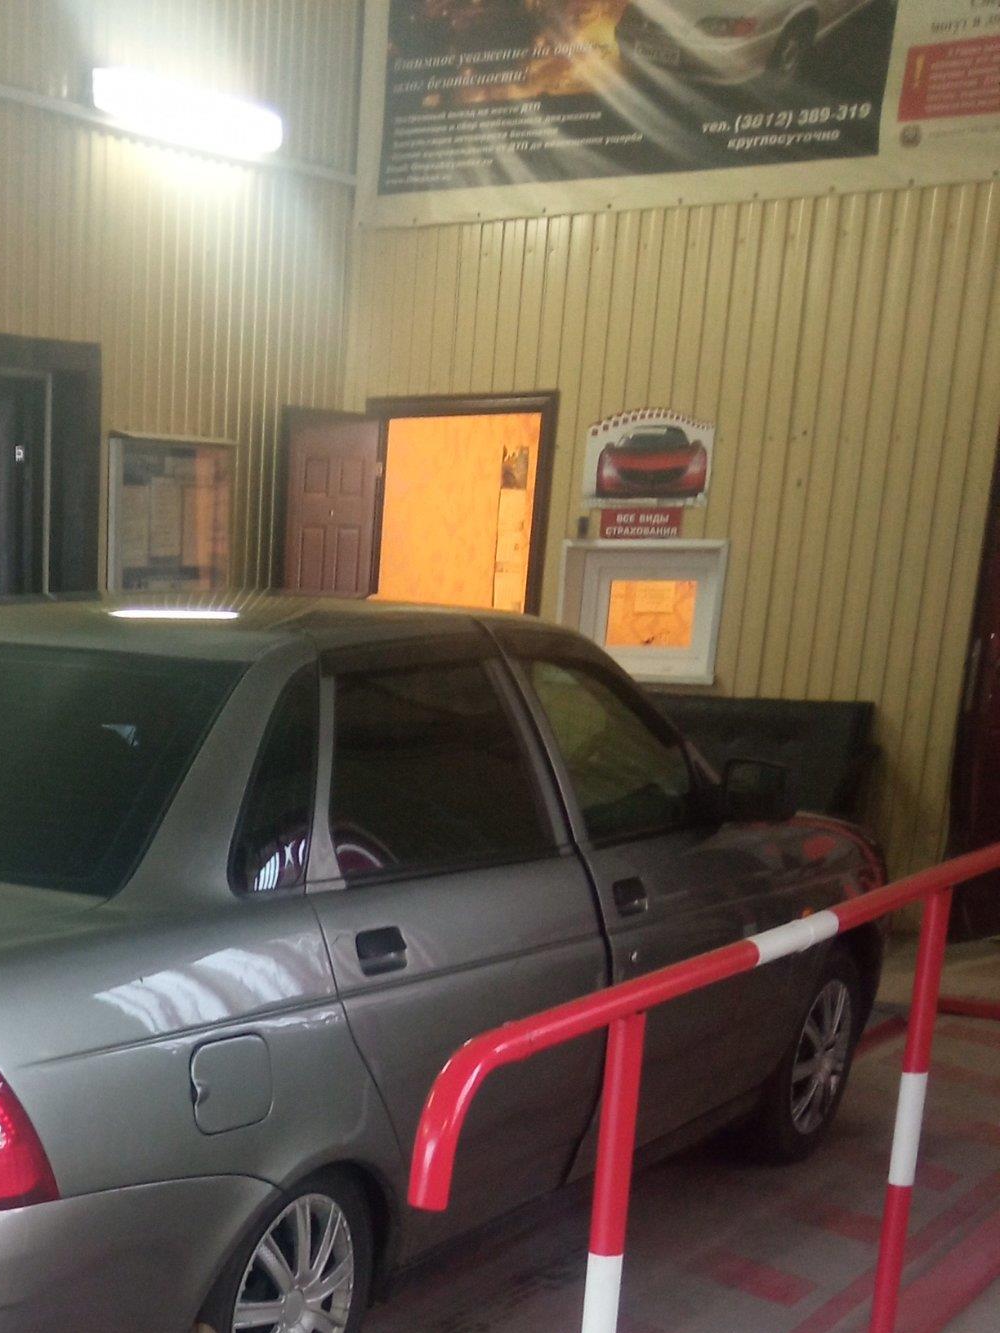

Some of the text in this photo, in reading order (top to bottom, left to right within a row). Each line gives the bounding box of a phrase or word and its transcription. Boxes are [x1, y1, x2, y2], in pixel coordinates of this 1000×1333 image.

[734, 109, 794, 134] (3812)
[797, 102, 872, 126] 389-319
[727, 129, 841, 151] круглосуточно
[616, 513, 671, 526] ВСЕ ВИДЫ
[605, 526, 679, 538] СТРАХОВАНИЯ
